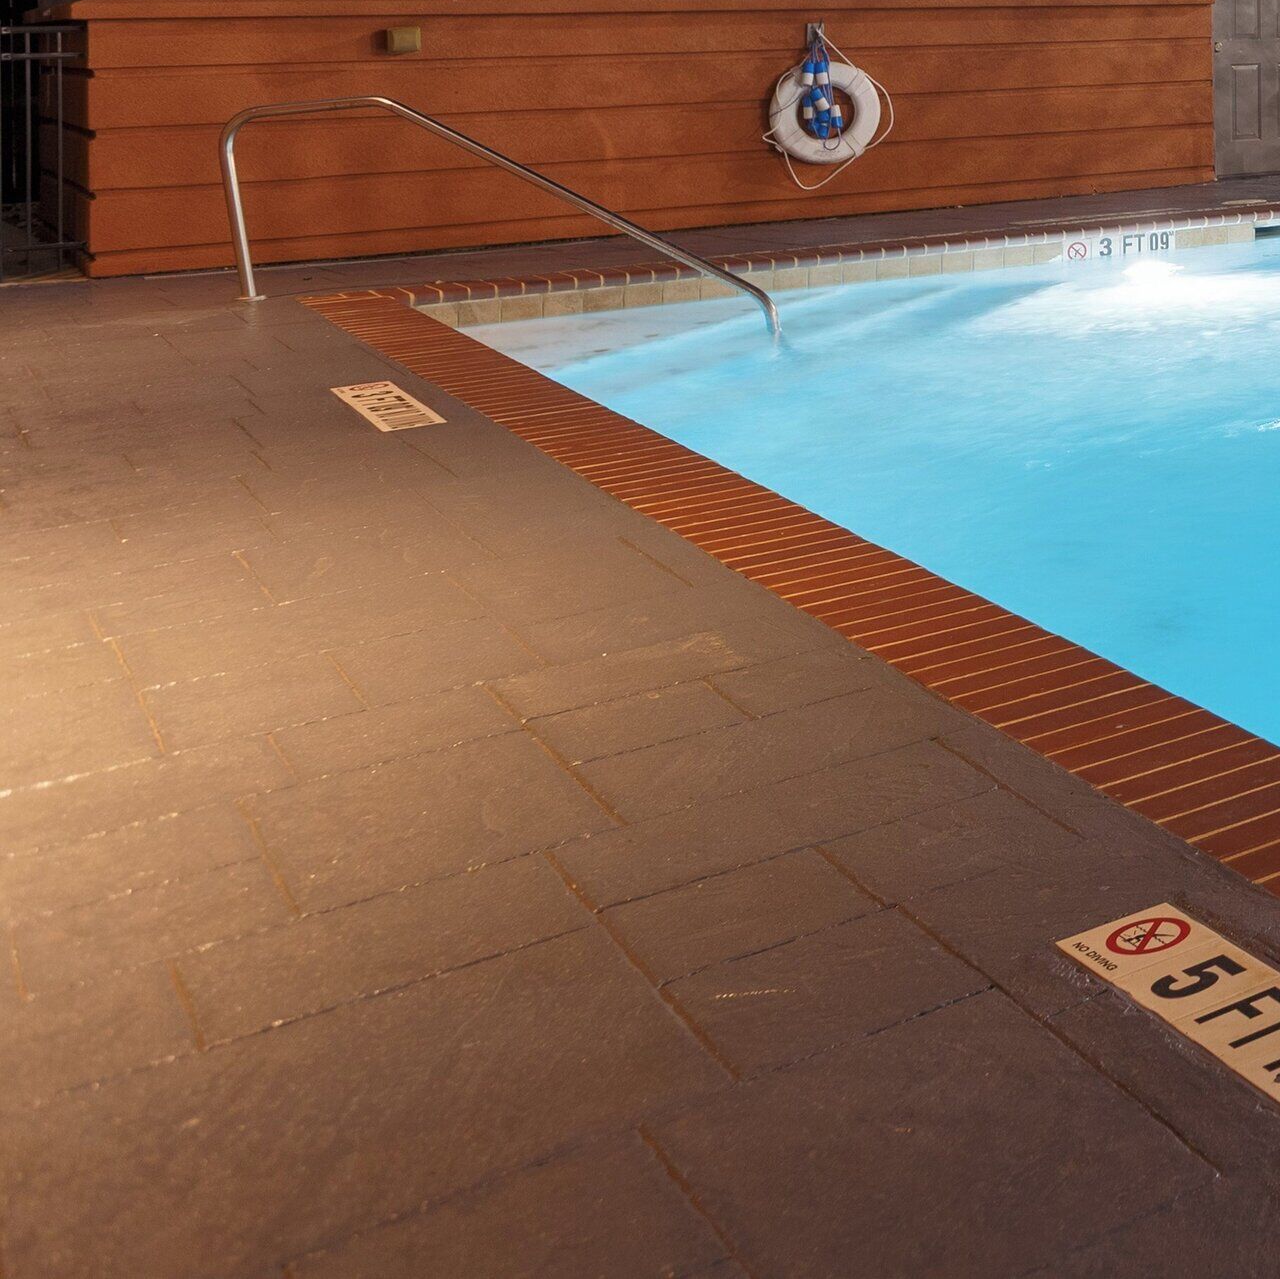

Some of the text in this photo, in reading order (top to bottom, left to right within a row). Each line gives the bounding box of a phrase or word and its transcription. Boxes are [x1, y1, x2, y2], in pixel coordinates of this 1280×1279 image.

[1099, 237, 1112, 257] 3
[1122, 233, 1145, 254] FT
[1072, 941, 1118, 971] NO DIVING
[1150, 954, 1247, 1000] 5
